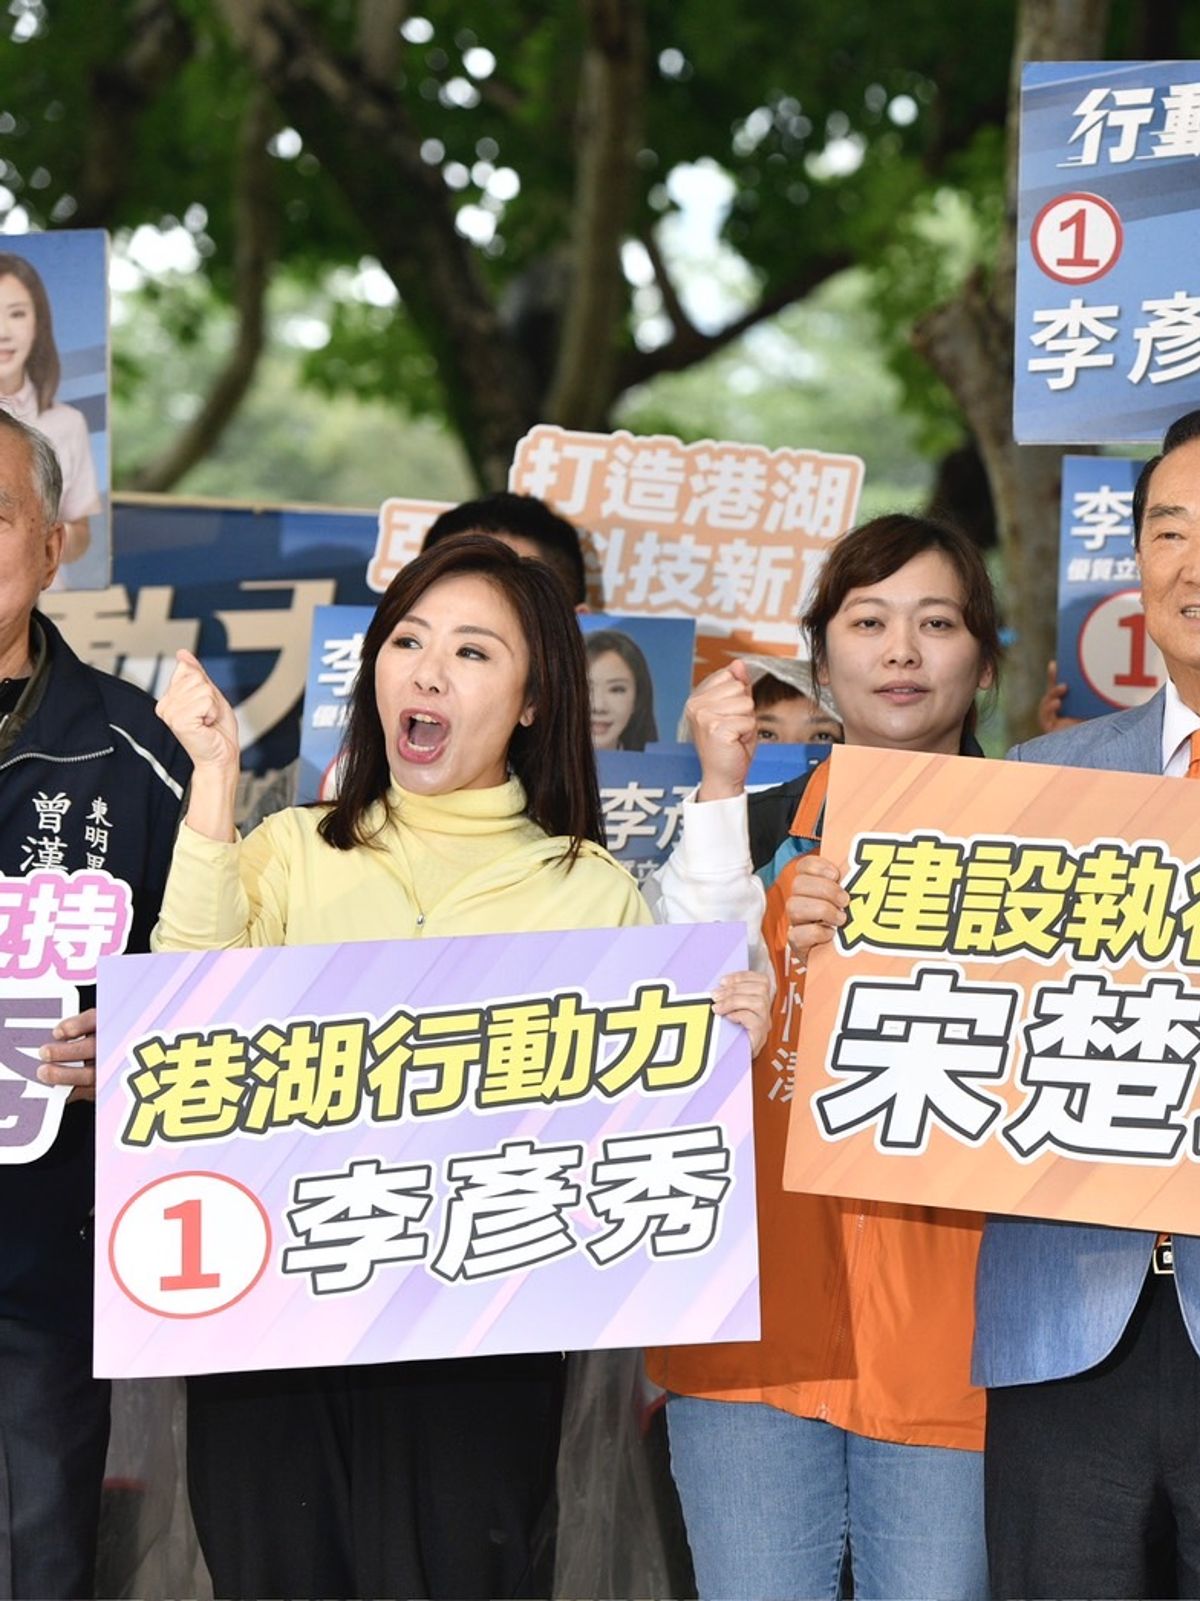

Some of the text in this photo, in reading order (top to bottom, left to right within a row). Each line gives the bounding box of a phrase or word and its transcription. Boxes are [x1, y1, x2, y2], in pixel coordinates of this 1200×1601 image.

[1055, 207, 1101, 268] 1
[519, 437, 850, 540] 打造港湖
[1114, 613, 1159, 688] 1
[0, 884, 117, 971] 持
[122, 984, 716, 1146] 港湖行動力
[159, 1198, 221, 1292] 1
[281, 1126, 731, 1296] 李彥秀
